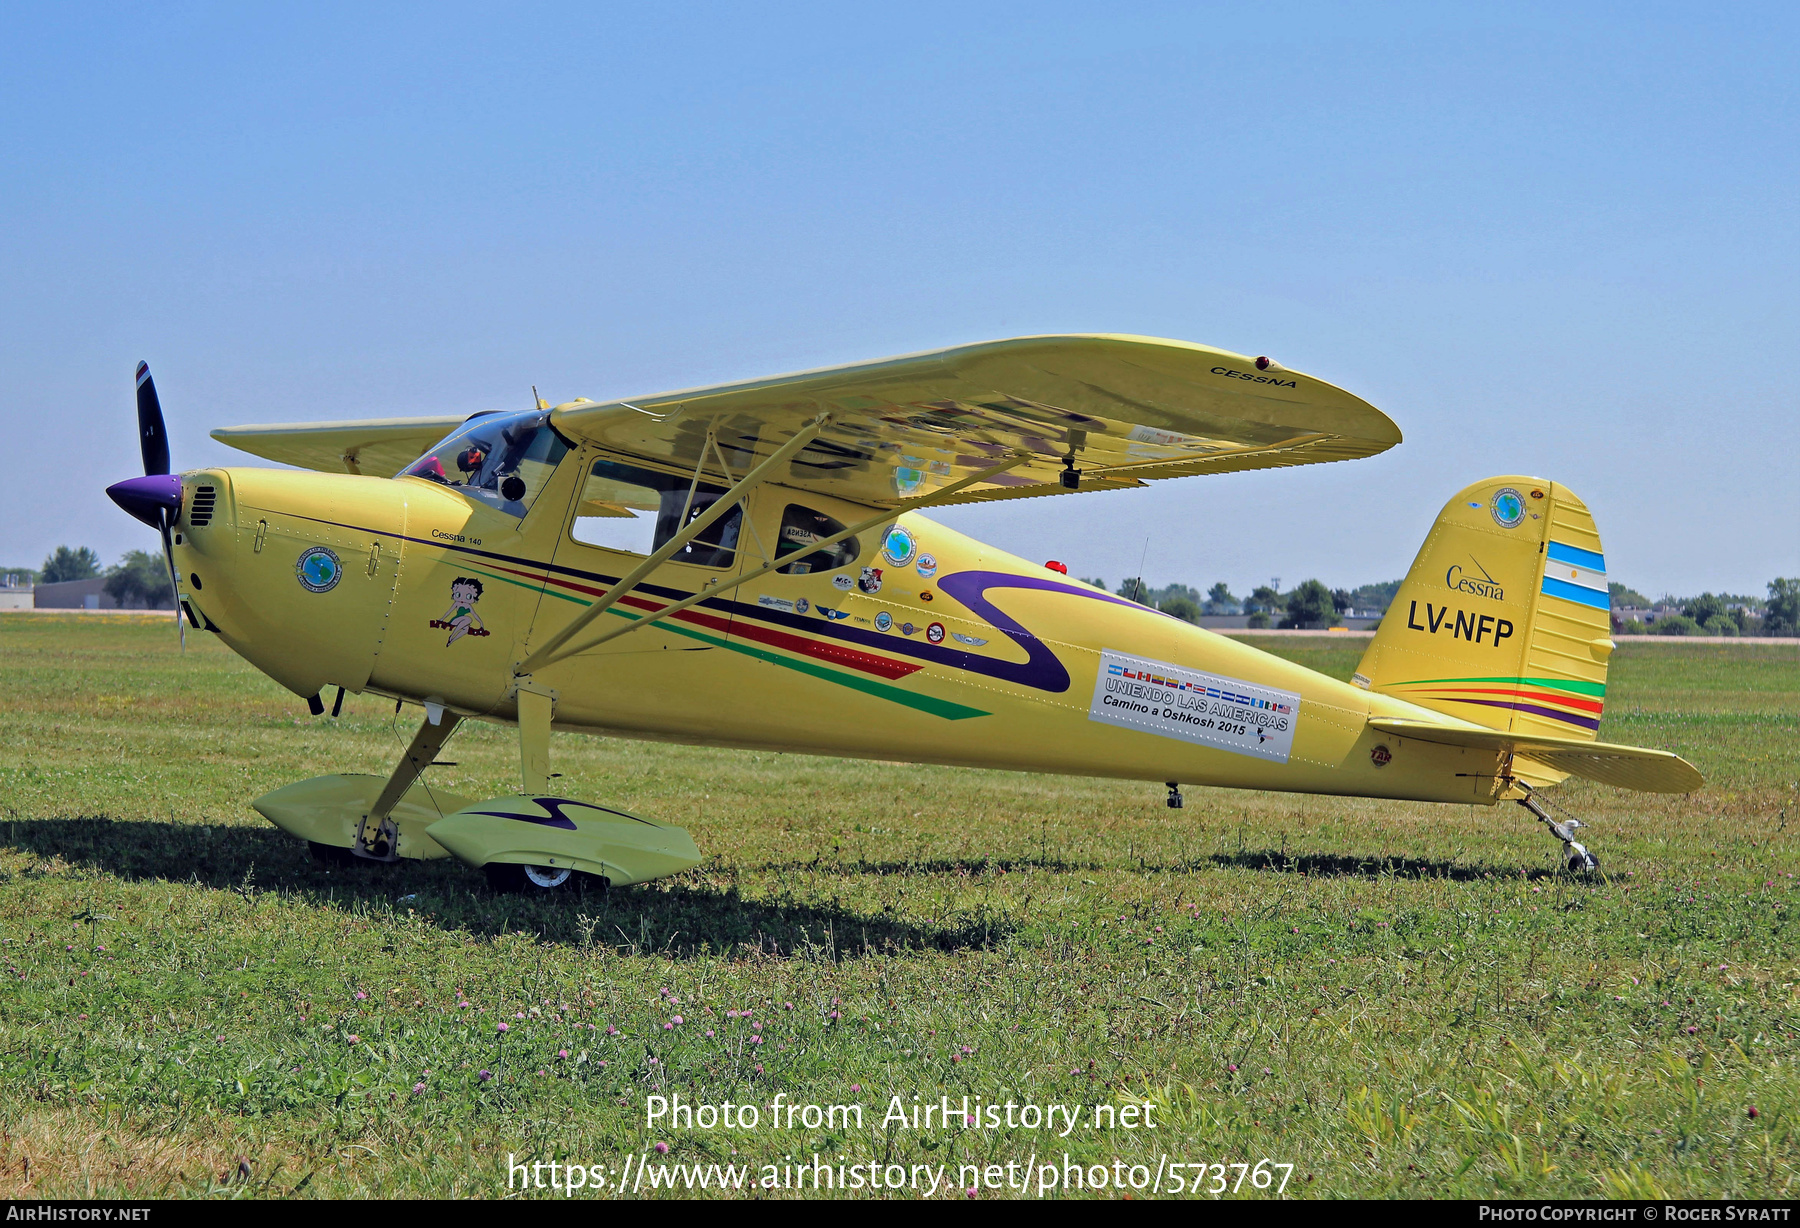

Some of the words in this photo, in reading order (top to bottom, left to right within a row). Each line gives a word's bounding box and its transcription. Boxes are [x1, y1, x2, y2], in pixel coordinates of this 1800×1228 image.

[1210, 366, 1297, 389] CESSNA
[431, 528, 466, 543] Cessna
[469, 537, 482, 546] 140
[1446, 564, 1504, 601] Cessna
[1407, 600, 1514, 647] LV-NFP
[1103, 694, 1149, 714] Camino
[1151, 708, 1159, 716] a
[1162, 708, 1215, 729] Oshkosh
[1217, 720, 1246, 735] 2015
[1105, 677, 1175, 705] UNIENDO
[1177, 693, 1208, 713] LAS
[1209, 703, 1289, 731] AMERICAS
[1370, 749, 1392, 762] TAR
